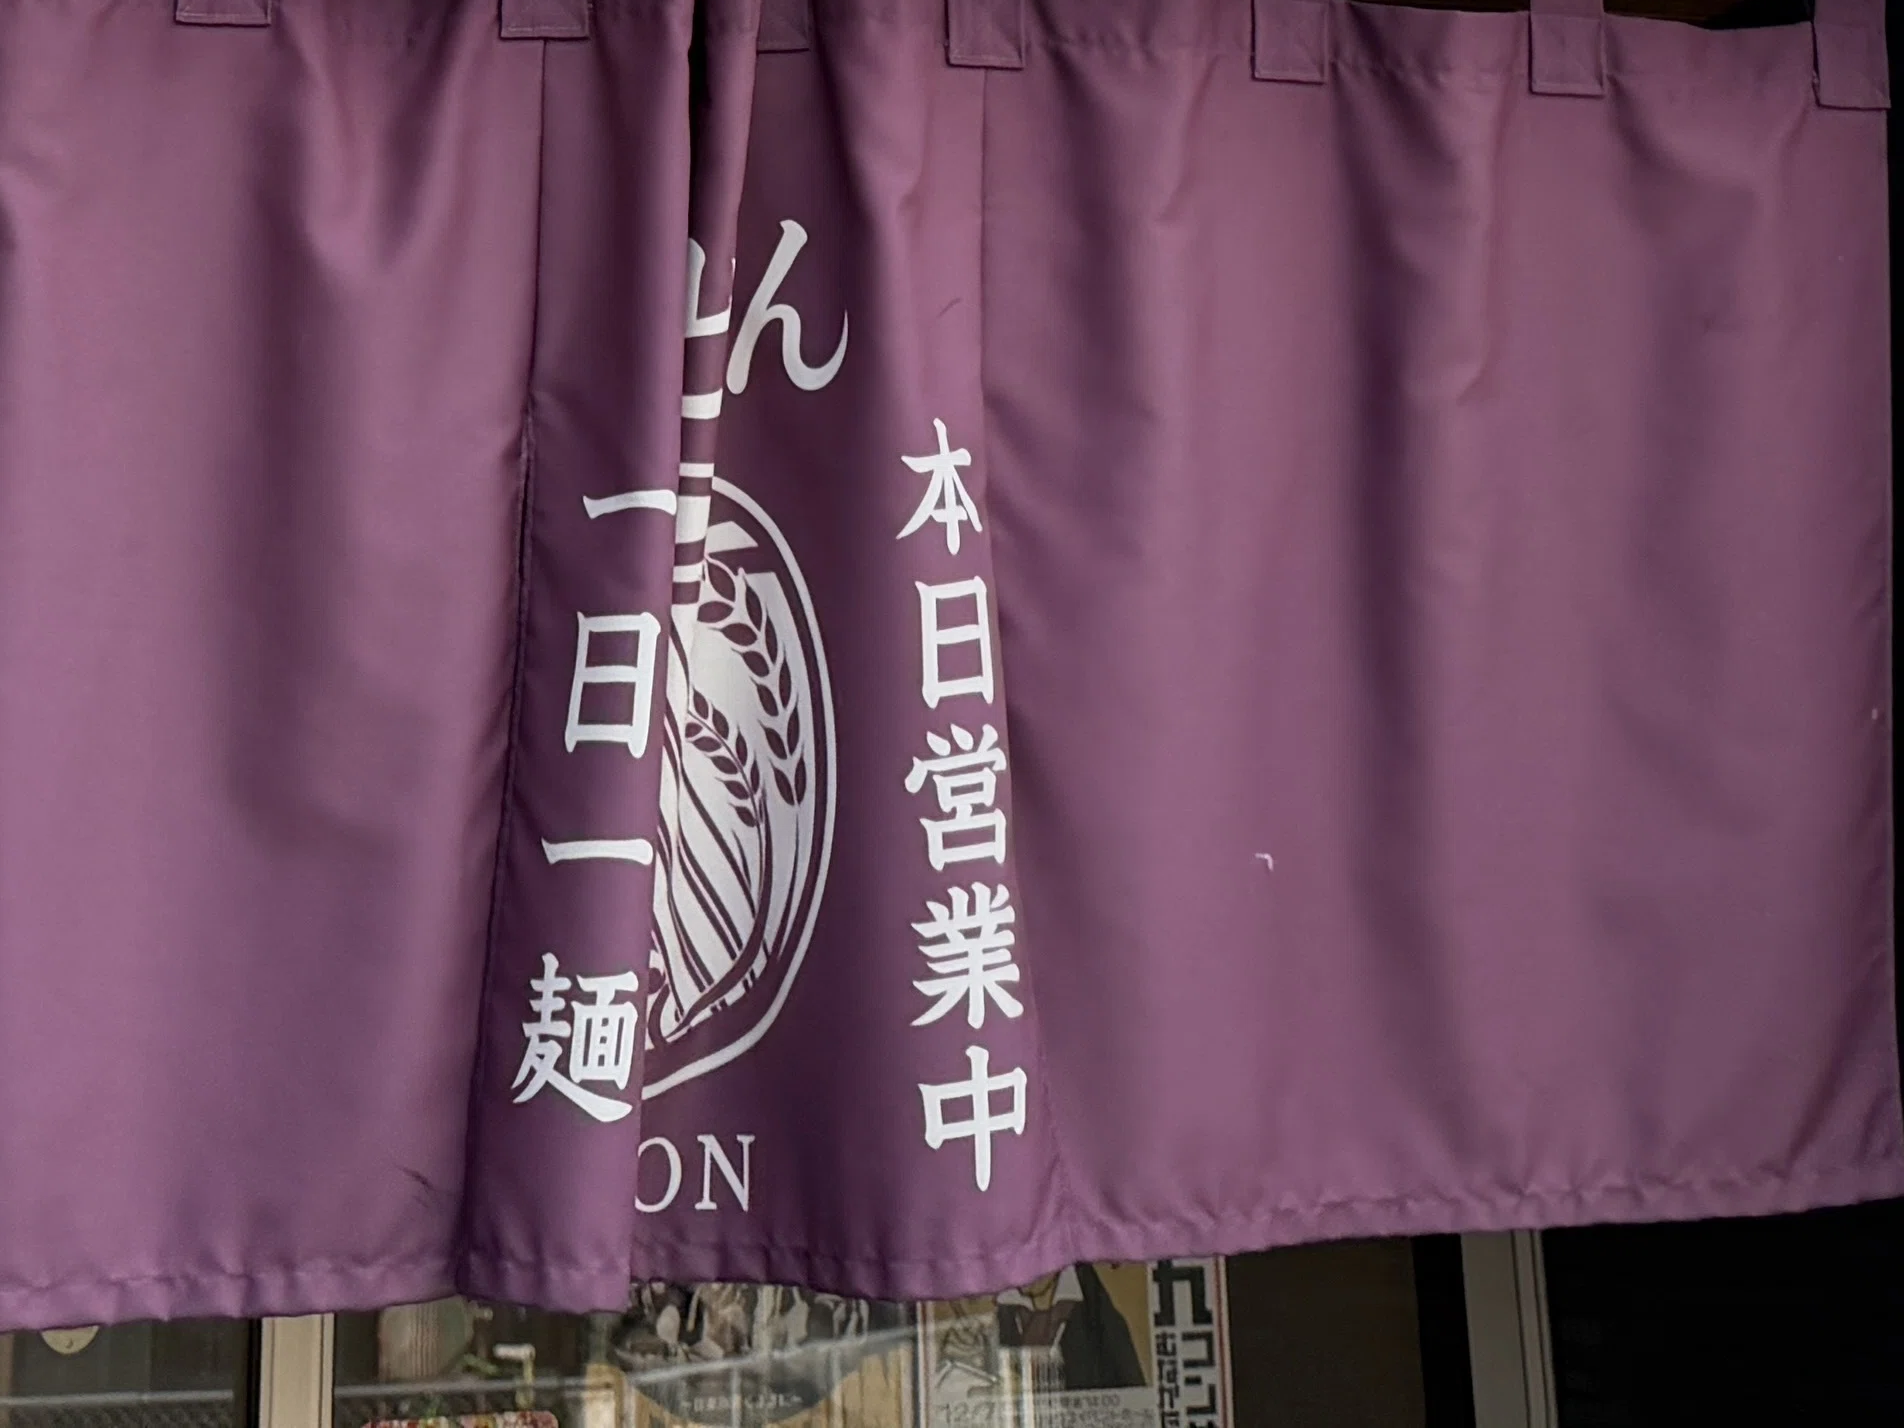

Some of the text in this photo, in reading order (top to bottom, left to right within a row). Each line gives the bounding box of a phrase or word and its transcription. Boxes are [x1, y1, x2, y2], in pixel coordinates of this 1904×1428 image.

[512, 488, 678, 1123] 一日一麺
[896, 417, 1030, 1193] 本日営業中
